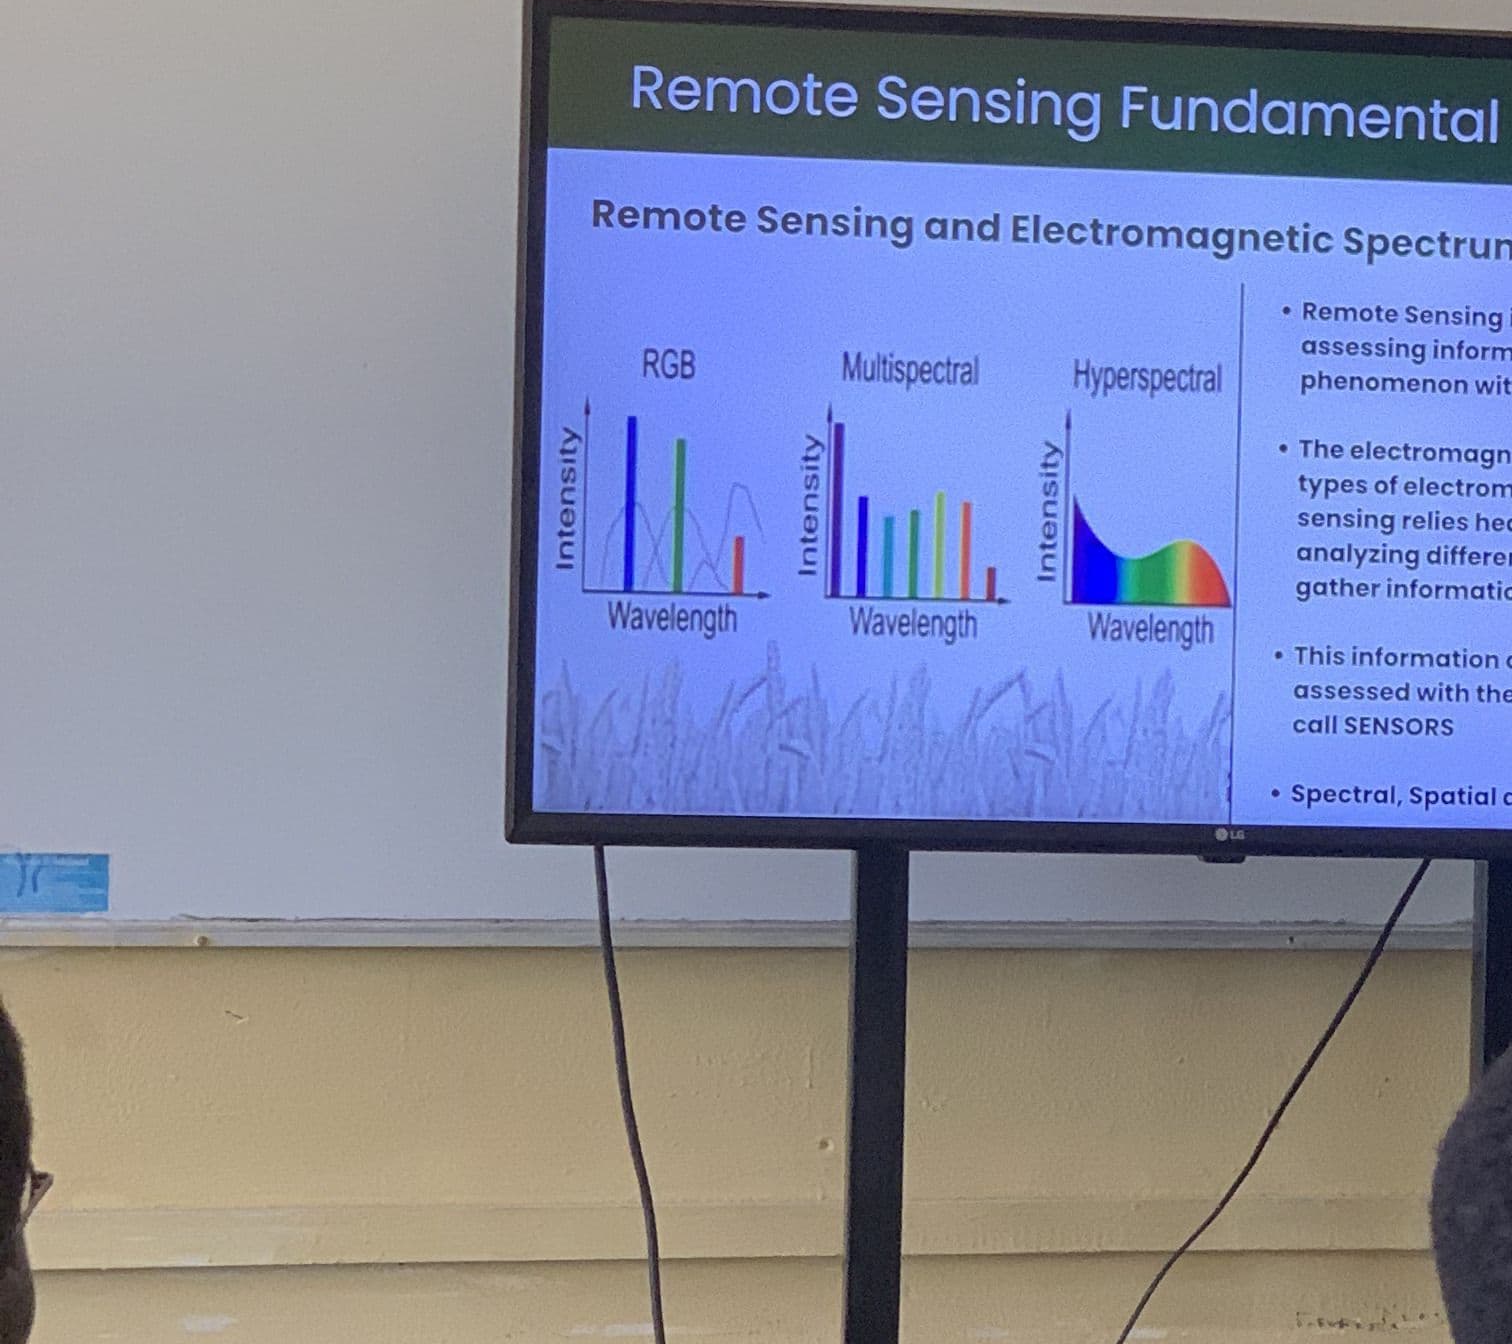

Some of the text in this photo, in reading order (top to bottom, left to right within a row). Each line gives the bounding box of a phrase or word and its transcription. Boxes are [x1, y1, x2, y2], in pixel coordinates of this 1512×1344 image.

[631, 64, 1500, 145] Remote Sensing Fundamental
[592, 197, 748, 233] Remote
[756, 205, 915, 250] Sensing
[924, 212, 1001, 249] and
[1010, 213, 1336, 262] Electromagnetic
[1302, 301, 1398, 323] Remote
[1404, 305, 1503, 333] Sensing
[643, 348, 697, 379] RGB
[1301, 336, 1427, 365] assessing
[842, 352, 979, 387] Multispectral
[1073, 358, 1222, 398] Hyperspectral
[1300, 369, 1469, 396] phenomenon
[1299, 438, 1345, 459] The
[555, 426, 583, 570] Intensity
[1298, 473, 1368, 499] types
[1373, 475, 1399, 495] of
[798, 433, 826, 576] Intensity
[1036, 439, 1064, 583] Intensity
[1297, 507, 1395, 536] sensing
[1401, 510, 1469, 532] relies
[1296, 543, 1420, 571] analyzing
[1295, 577, 1382, 603] gather
[607, 601, 738, 640] Wavelength
[850, 606, 978, 645] Wavelength
[1088, 610, 1214, 651] Wavelength
[1294, 645, 1346, 666] This
[1351, 645, 1500, 669] information
[1293, 682, 1411, 702] assessed
[1416, 682, 1470, 703] with
[1292, 715, 1455, 737] call SENSORS
[1290, 783, 1403, 809] Spectral,
[1409, 785, 1497, 812] Spatial
[1229, 830, 1245, 840] LG
